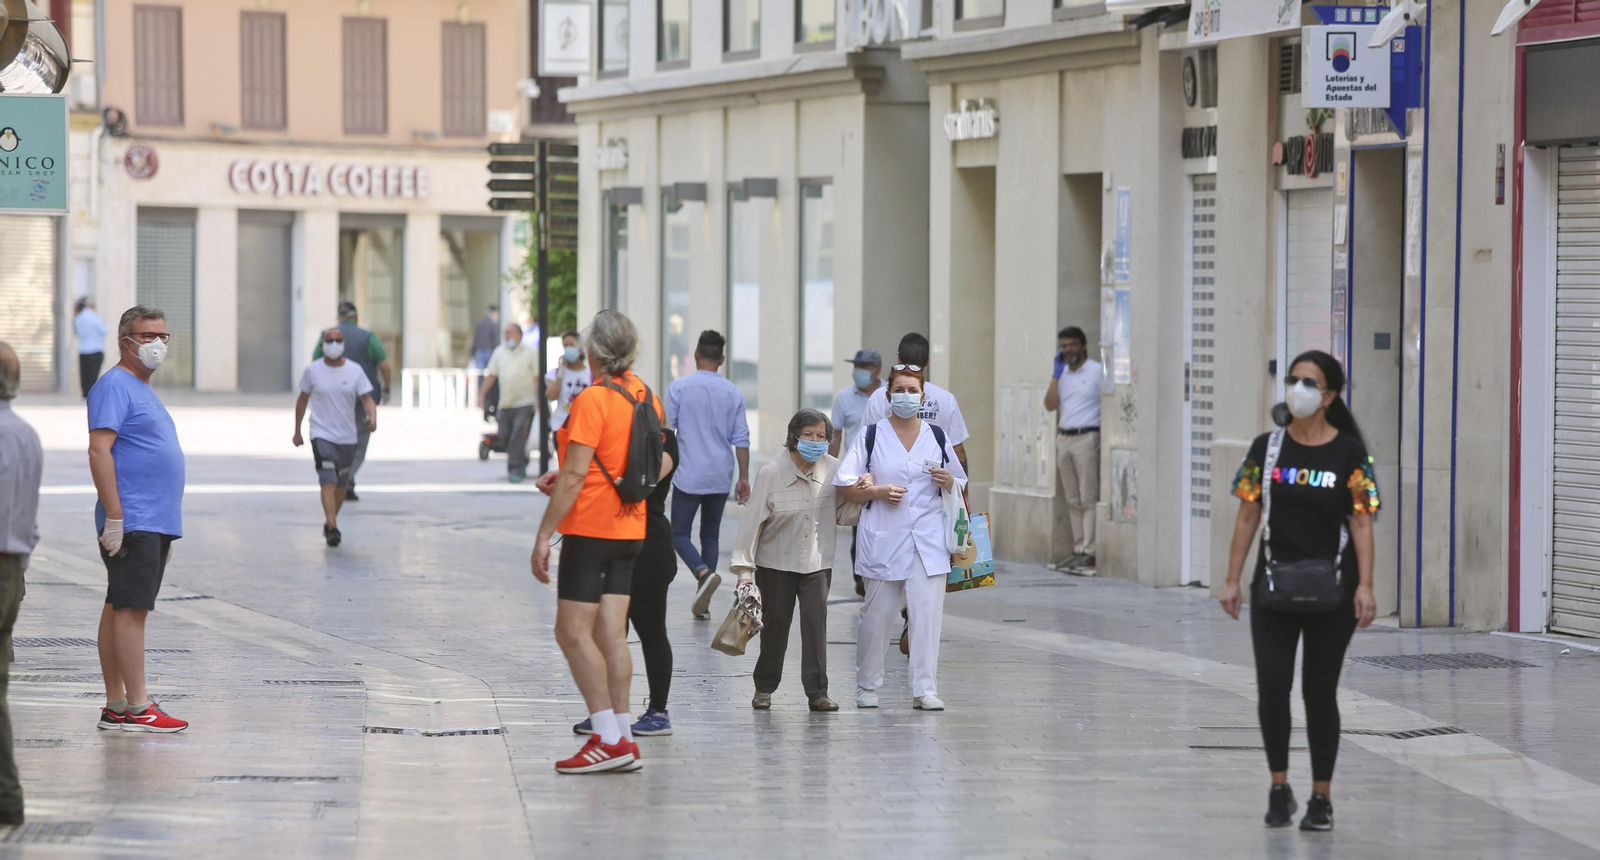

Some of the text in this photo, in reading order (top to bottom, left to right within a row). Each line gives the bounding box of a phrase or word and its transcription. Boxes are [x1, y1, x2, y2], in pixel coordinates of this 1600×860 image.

[1325, 74, 1365, 84] Loterías y
[1325, 84, 1377, 93] Apuestas del
[228, 158, 430, 200] COSTA COFFEE
[1271, 466, 1337, 489] AMOUR
